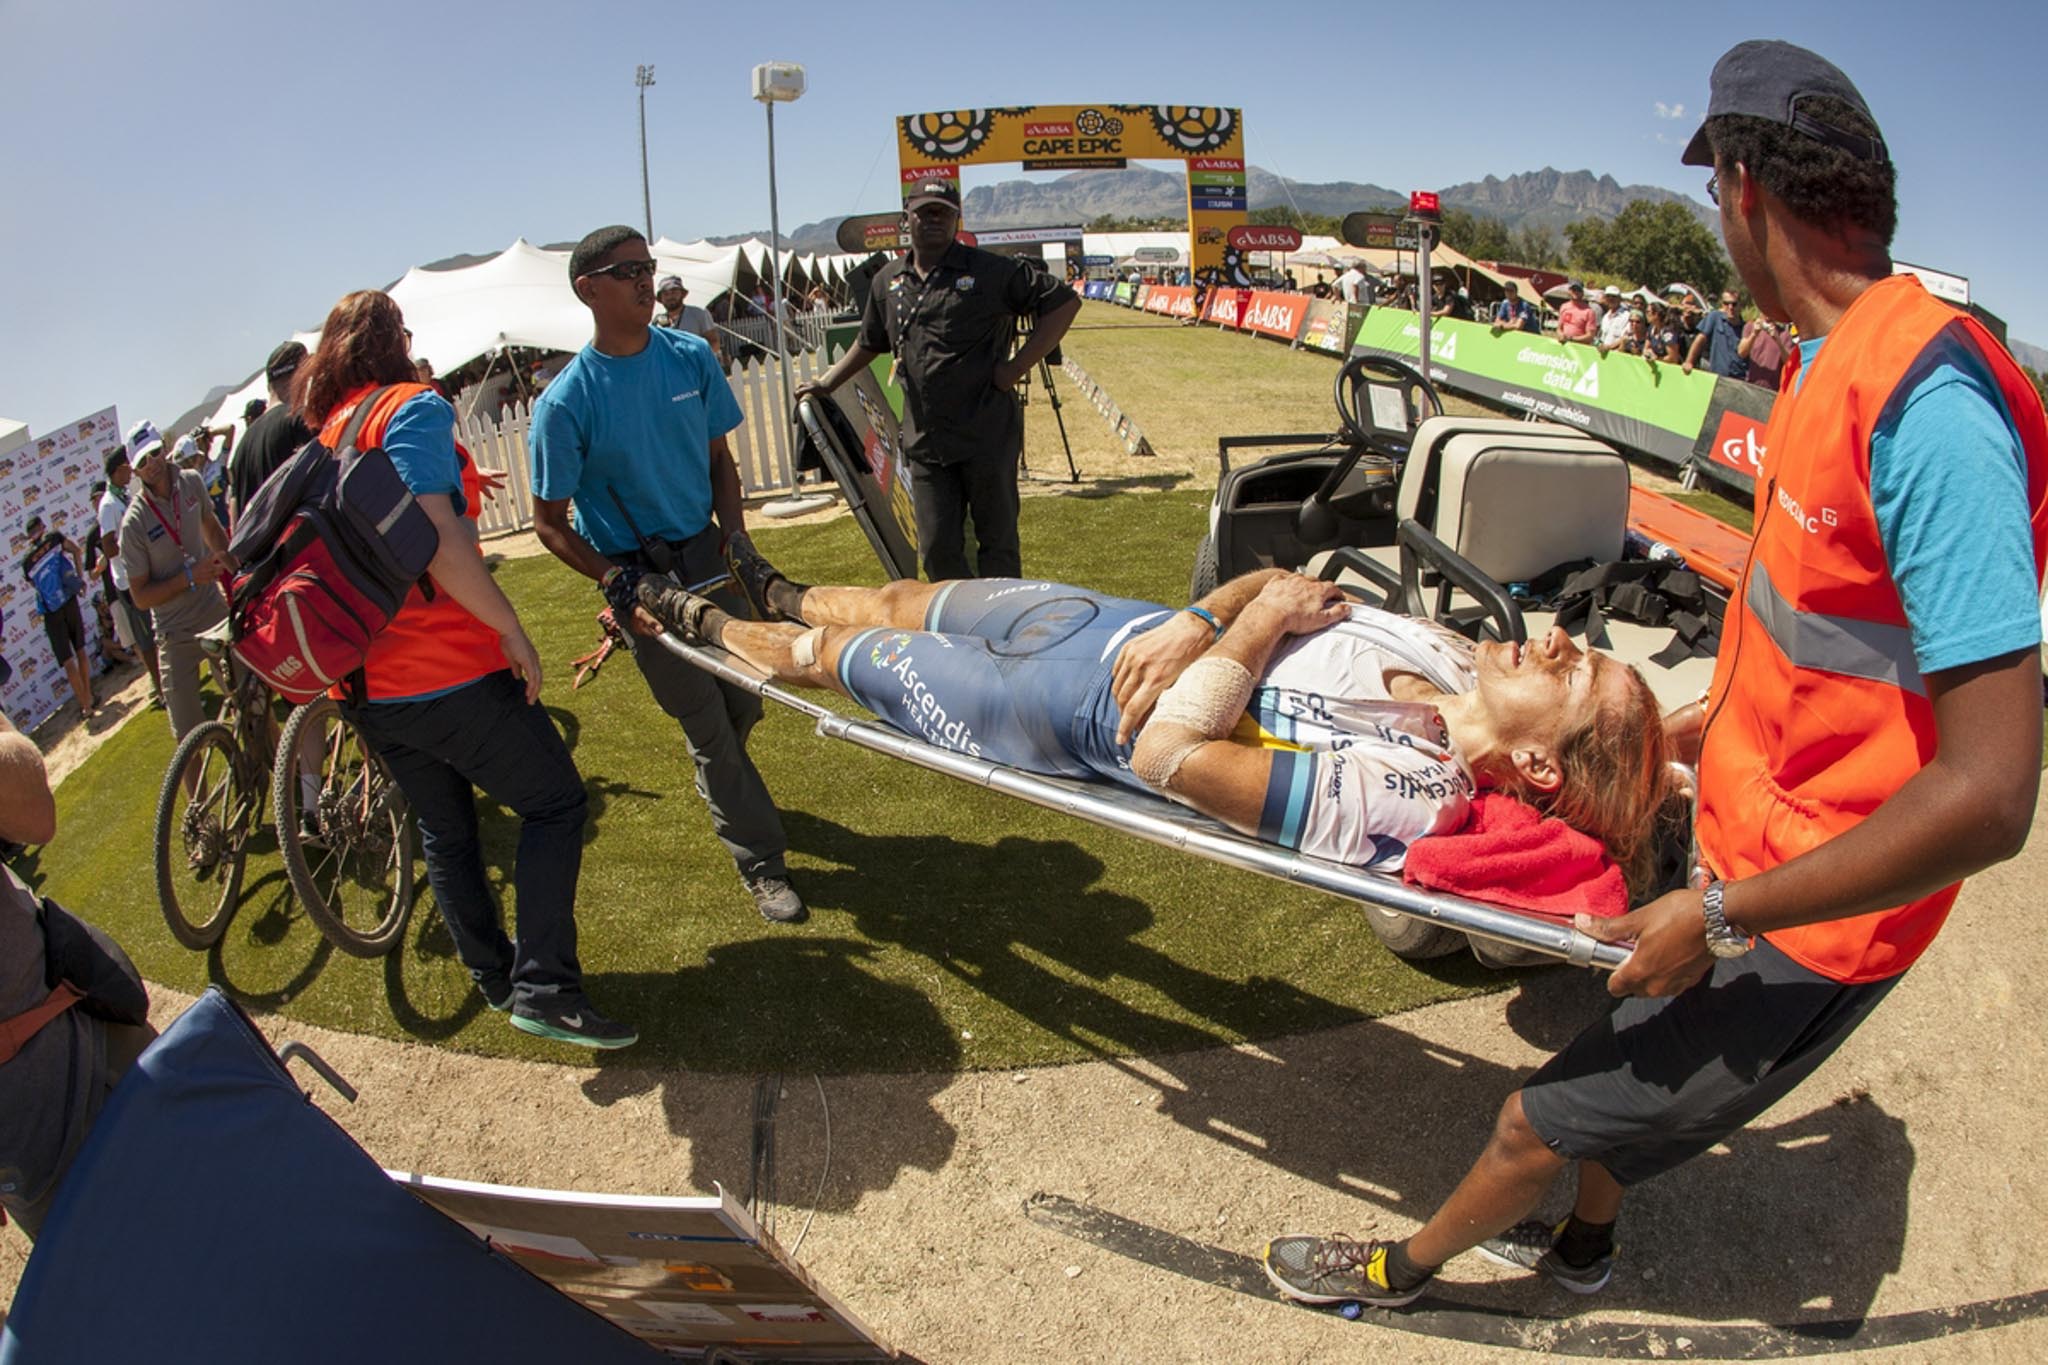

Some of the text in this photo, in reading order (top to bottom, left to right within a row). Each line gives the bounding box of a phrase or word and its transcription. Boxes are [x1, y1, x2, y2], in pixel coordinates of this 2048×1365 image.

[1040, 125, 1070, 134] ABSA
[1023, 138, 1122, 155] CAPE EPIC
[922, 167, 951, 178] ABSA
[1212, 160, 1240, 169] ABSA
[1257, 233, 1296, 246] ABSA
[1260, 304, 1294, 332] ABSA
[1516, 346, 1580, 374] dimension
[1542, 369, 1574, 391] data
[891, 655, 982, 757] Ascendis
